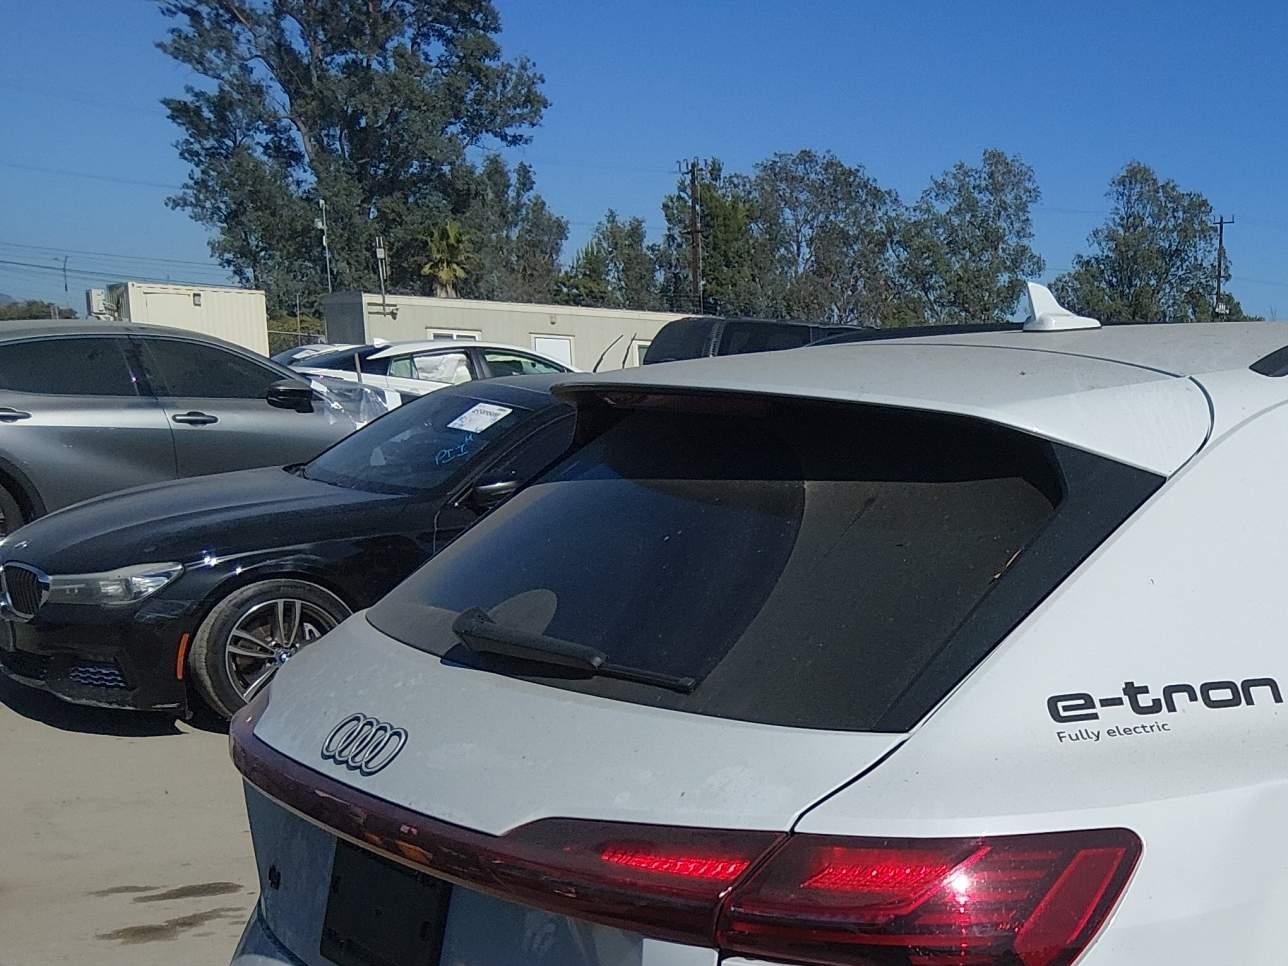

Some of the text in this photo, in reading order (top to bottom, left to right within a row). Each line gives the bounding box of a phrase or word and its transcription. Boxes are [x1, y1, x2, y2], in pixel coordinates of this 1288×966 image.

[1047, 677, 1284, 723] e-tron
[1056, 721, 1171, 743] Fully electric
